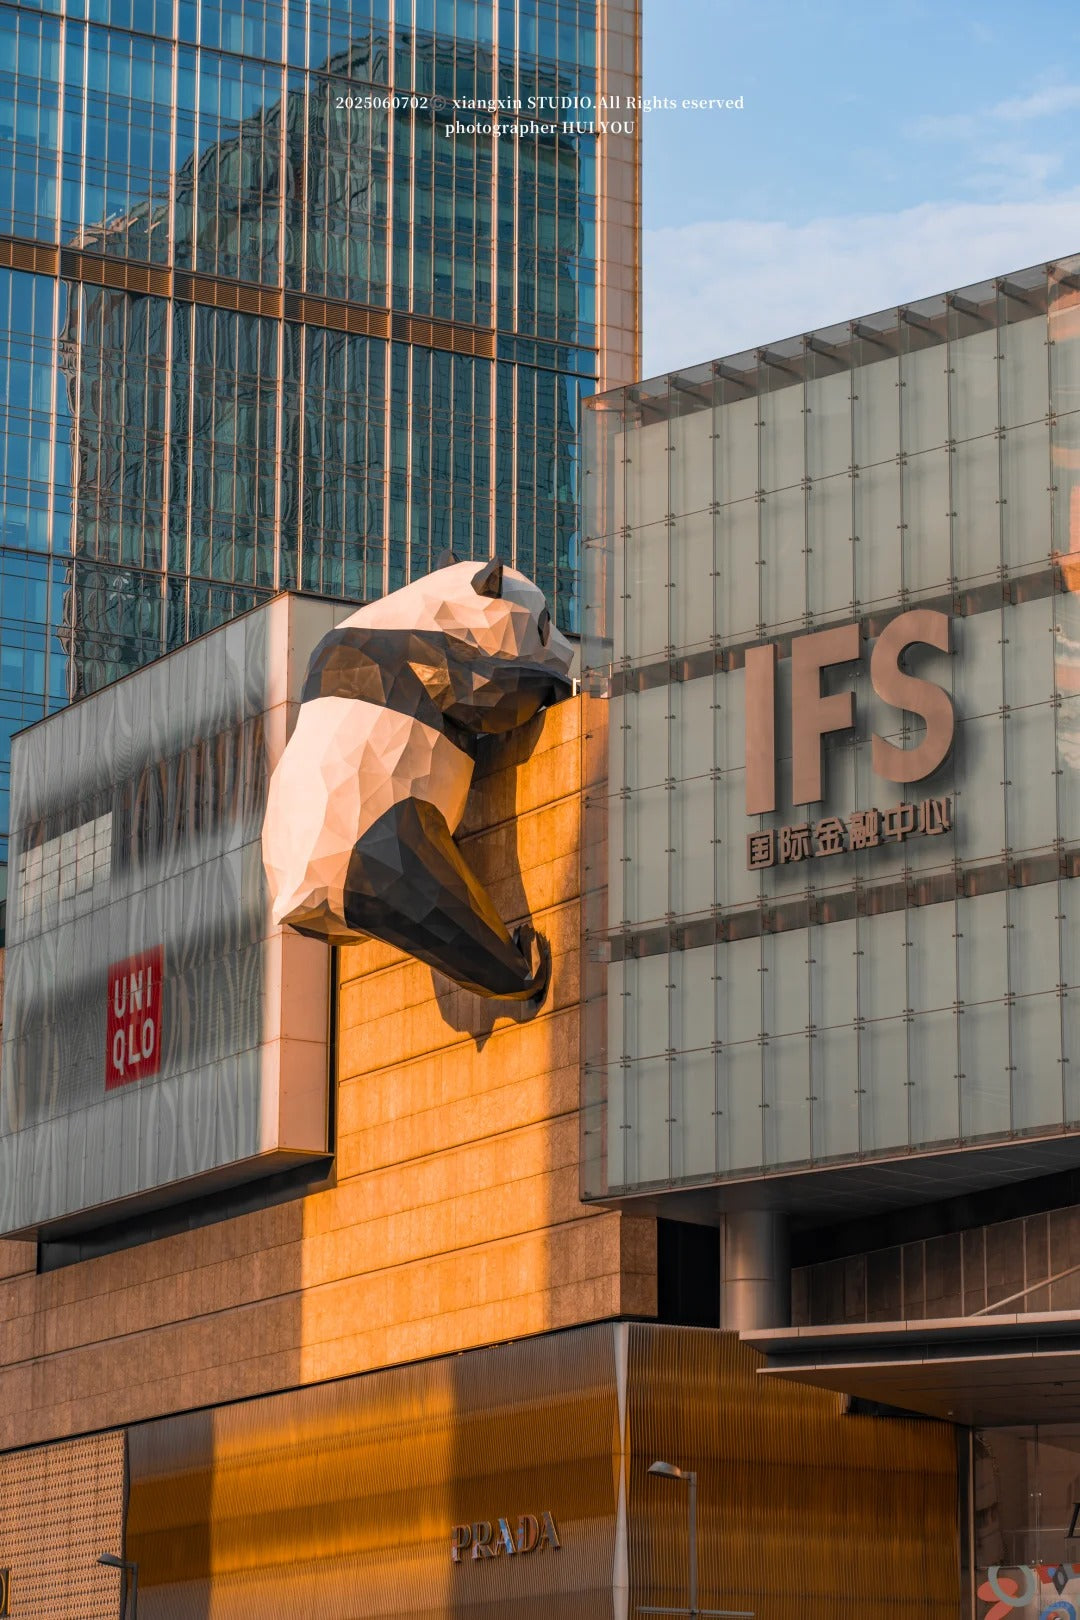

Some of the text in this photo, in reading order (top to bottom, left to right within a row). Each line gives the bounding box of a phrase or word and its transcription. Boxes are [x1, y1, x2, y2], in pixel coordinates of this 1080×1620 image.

[745, 609, 954, 816] IFS
[747, 798, 951, 870] 国际金融中心
[114, 966, 152, 1018] UNI
[112, 1018, 155, 1076] QLO
[451, 1511, 561, 1562] PRADA
